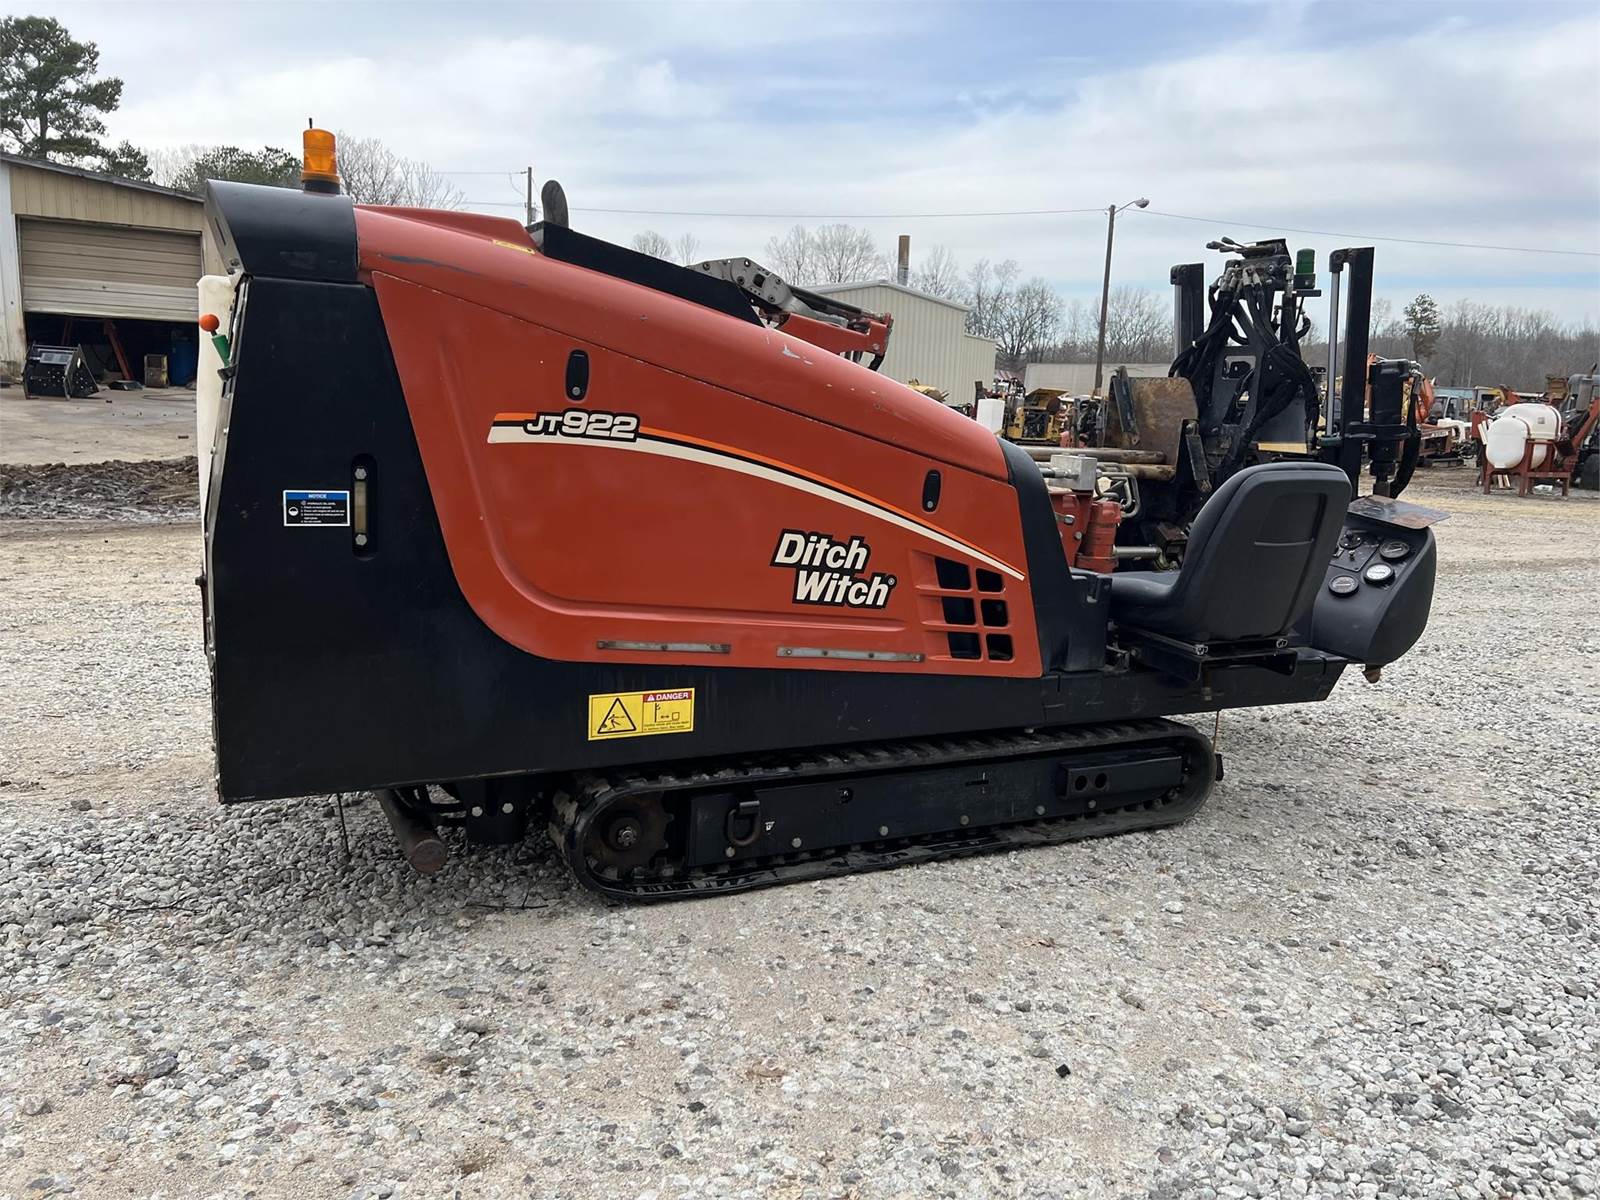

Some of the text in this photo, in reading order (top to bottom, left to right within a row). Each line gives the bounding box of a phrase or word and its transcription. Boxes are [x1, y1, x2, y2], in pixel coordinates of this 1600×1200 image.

[525, 410, 638, 439] JT922
[774, 532, 868, 570] Ditch
[656, 692, 689, 701] DANGER
